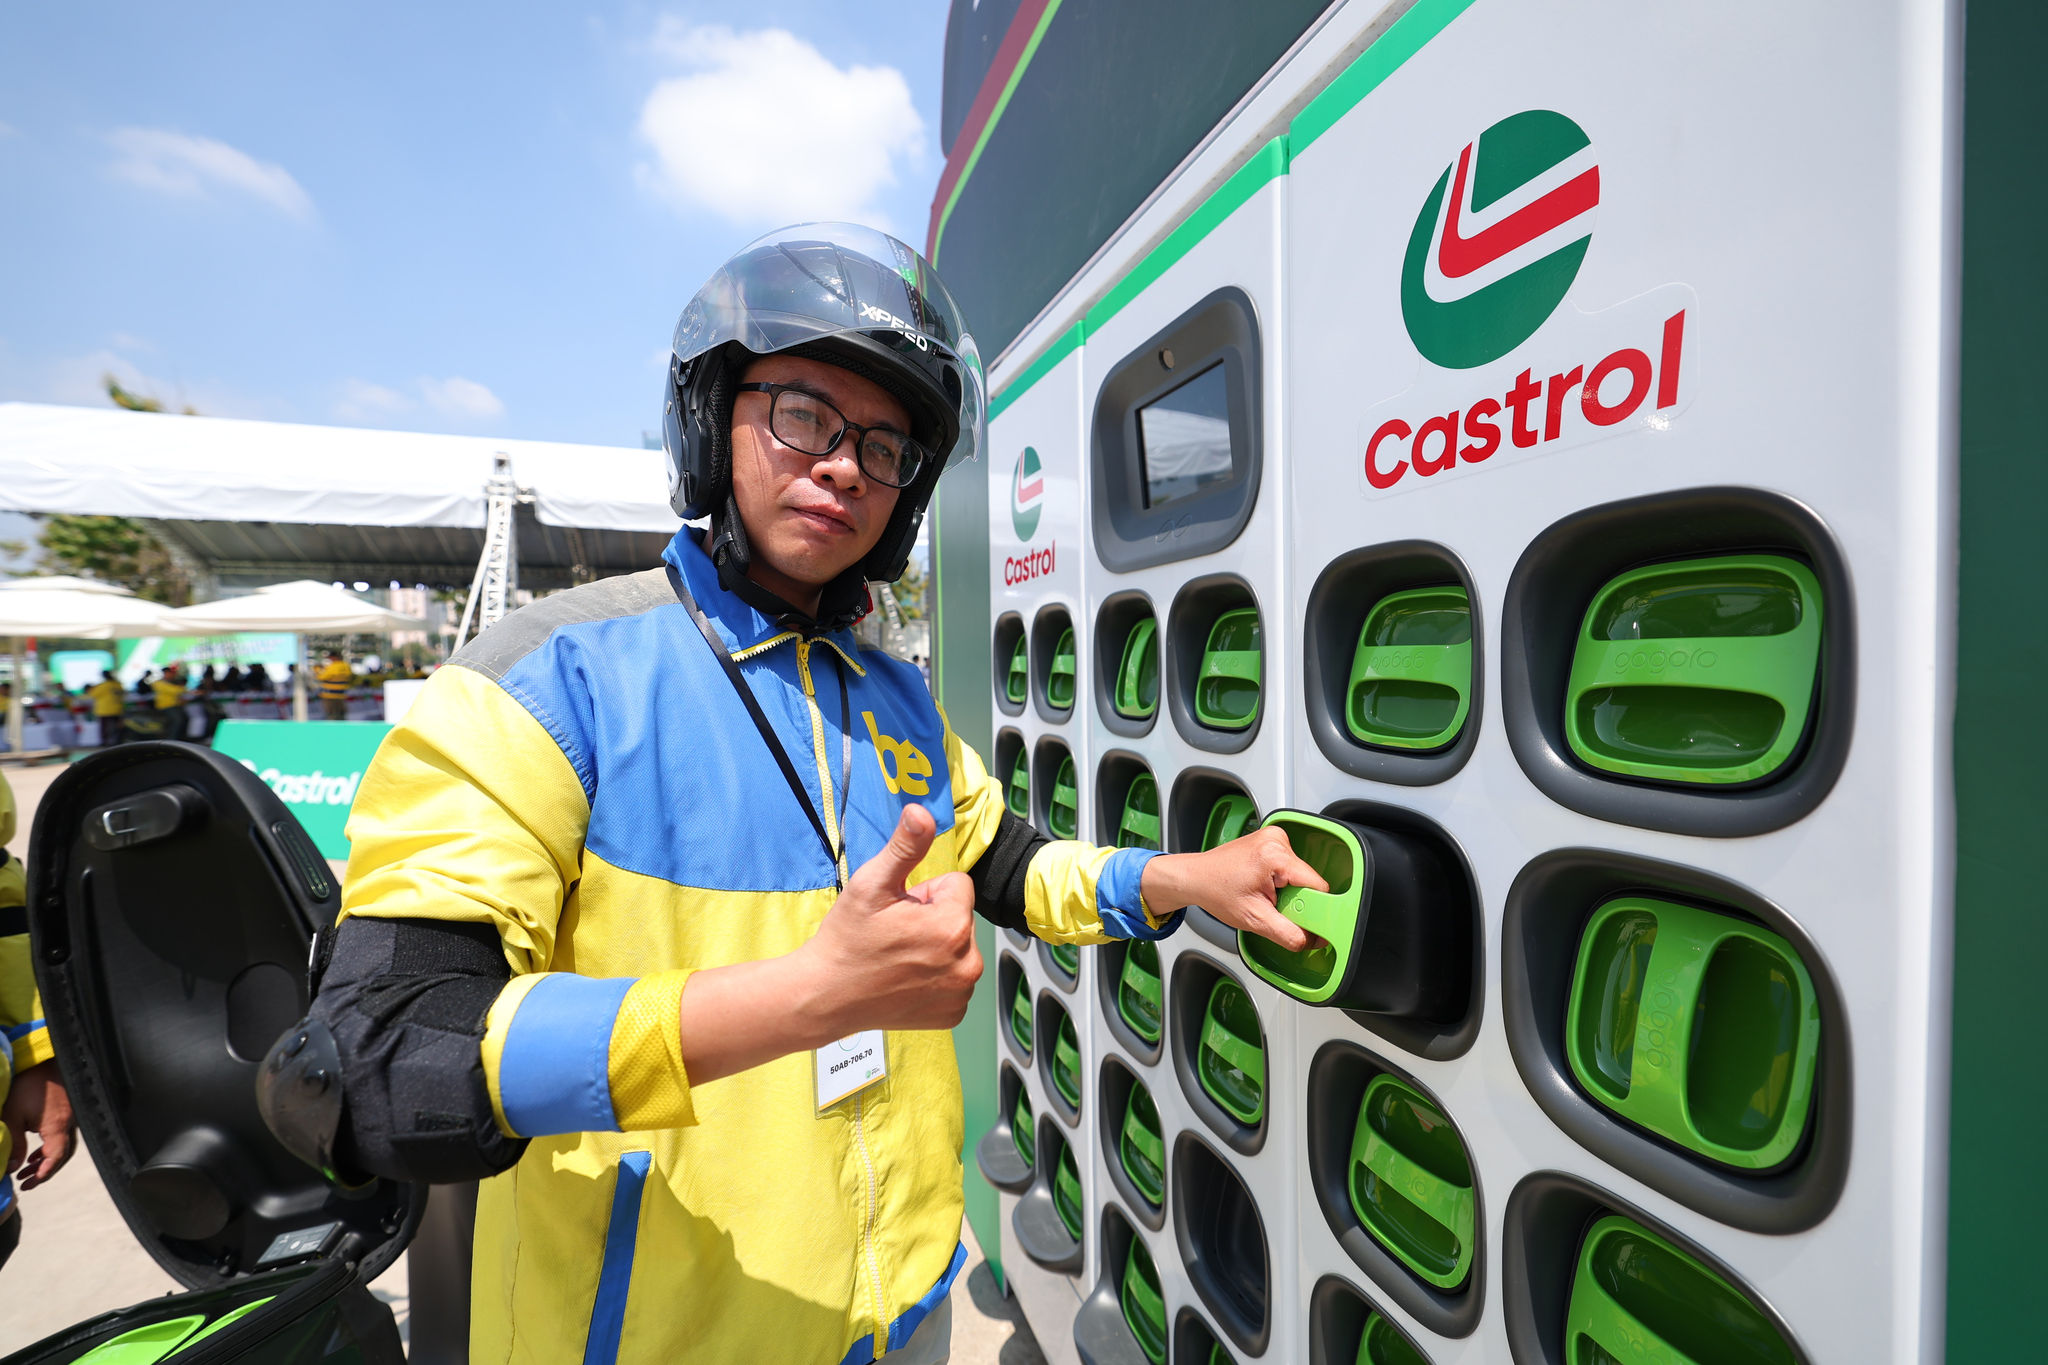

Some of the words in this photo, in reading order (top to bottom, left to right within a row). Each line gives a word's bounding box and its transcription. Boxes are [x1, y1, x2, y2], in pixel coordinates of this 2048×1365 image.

[859, 302, 928, 352] XPEED
[1364, 308, 1686, 489] Castrol
[1004, 539, 1056, 587] Castrol
[1614, 647, 1719, 675] gogoro
[861, 711, 933, 796] be
[259, 767, 361, 806] Castrol
[1646, 968, 1678, 1069] gogoro
[829, 1048, 873, 1075] 50AB-706.70
